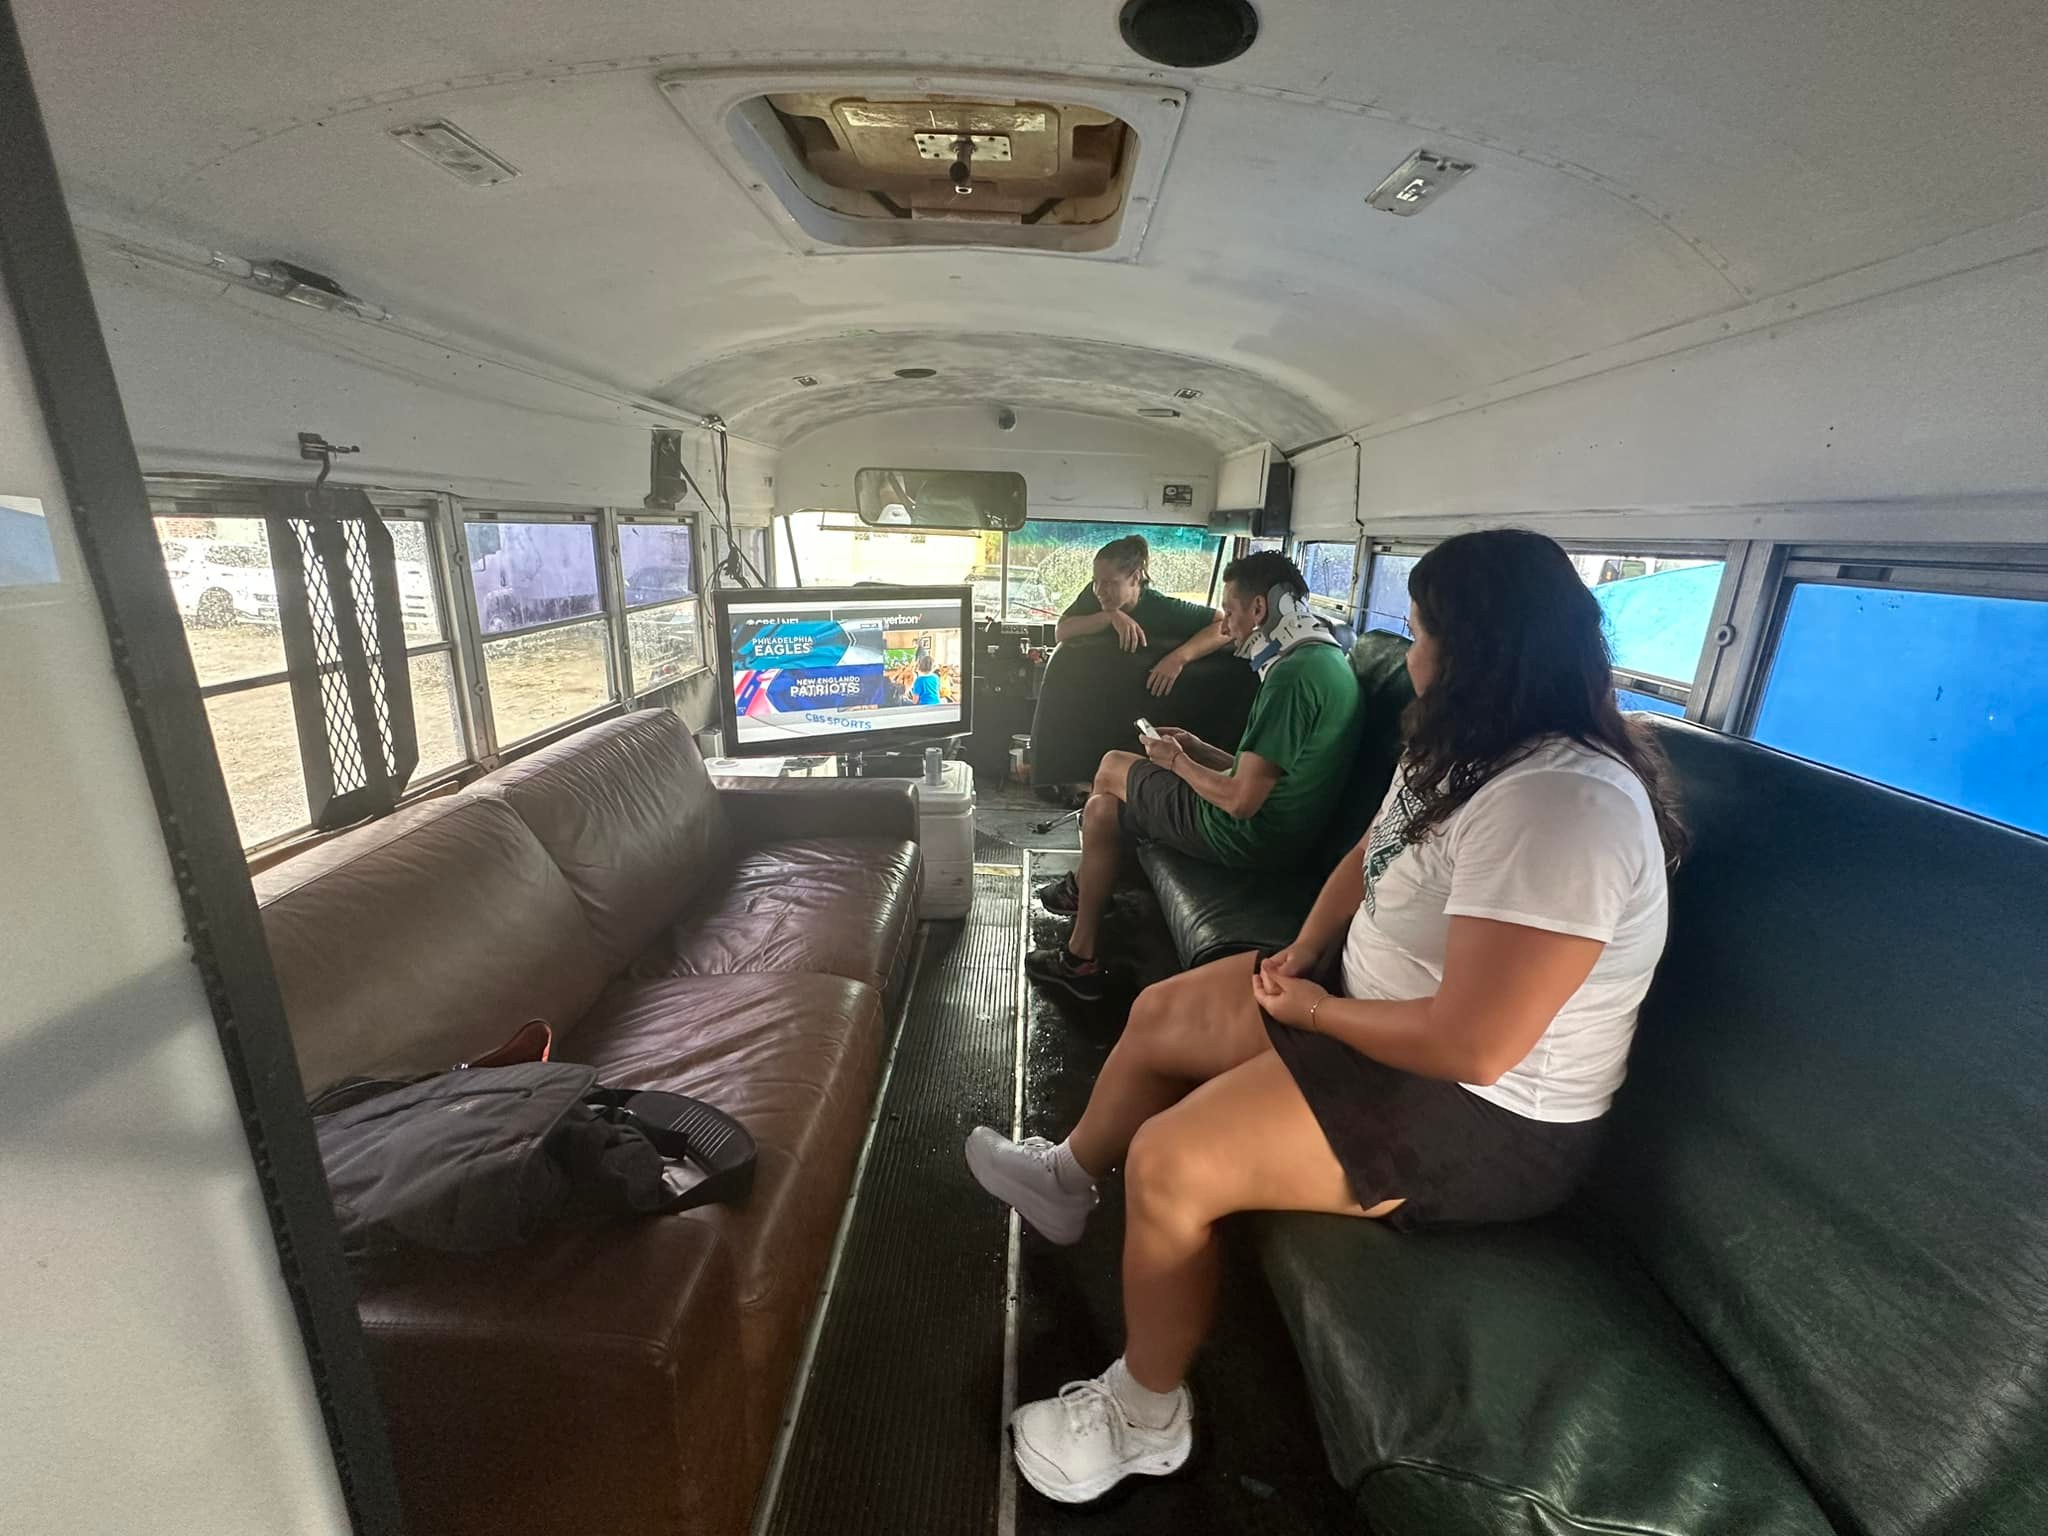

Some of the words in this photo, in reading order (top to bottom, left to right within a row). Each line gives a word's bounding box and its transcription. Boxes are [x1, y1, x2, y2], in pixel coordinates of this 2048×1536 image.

[883, 614, 919, 625] verizon
[752, 636, 814, 646] PHILADELPHIA
[754, 643, 813, 657] EAGLES
[796, 677, 816, 686] NEW
[805, 713, 826, 723] CBS
[826, 717, 872, 729] SPORTS
